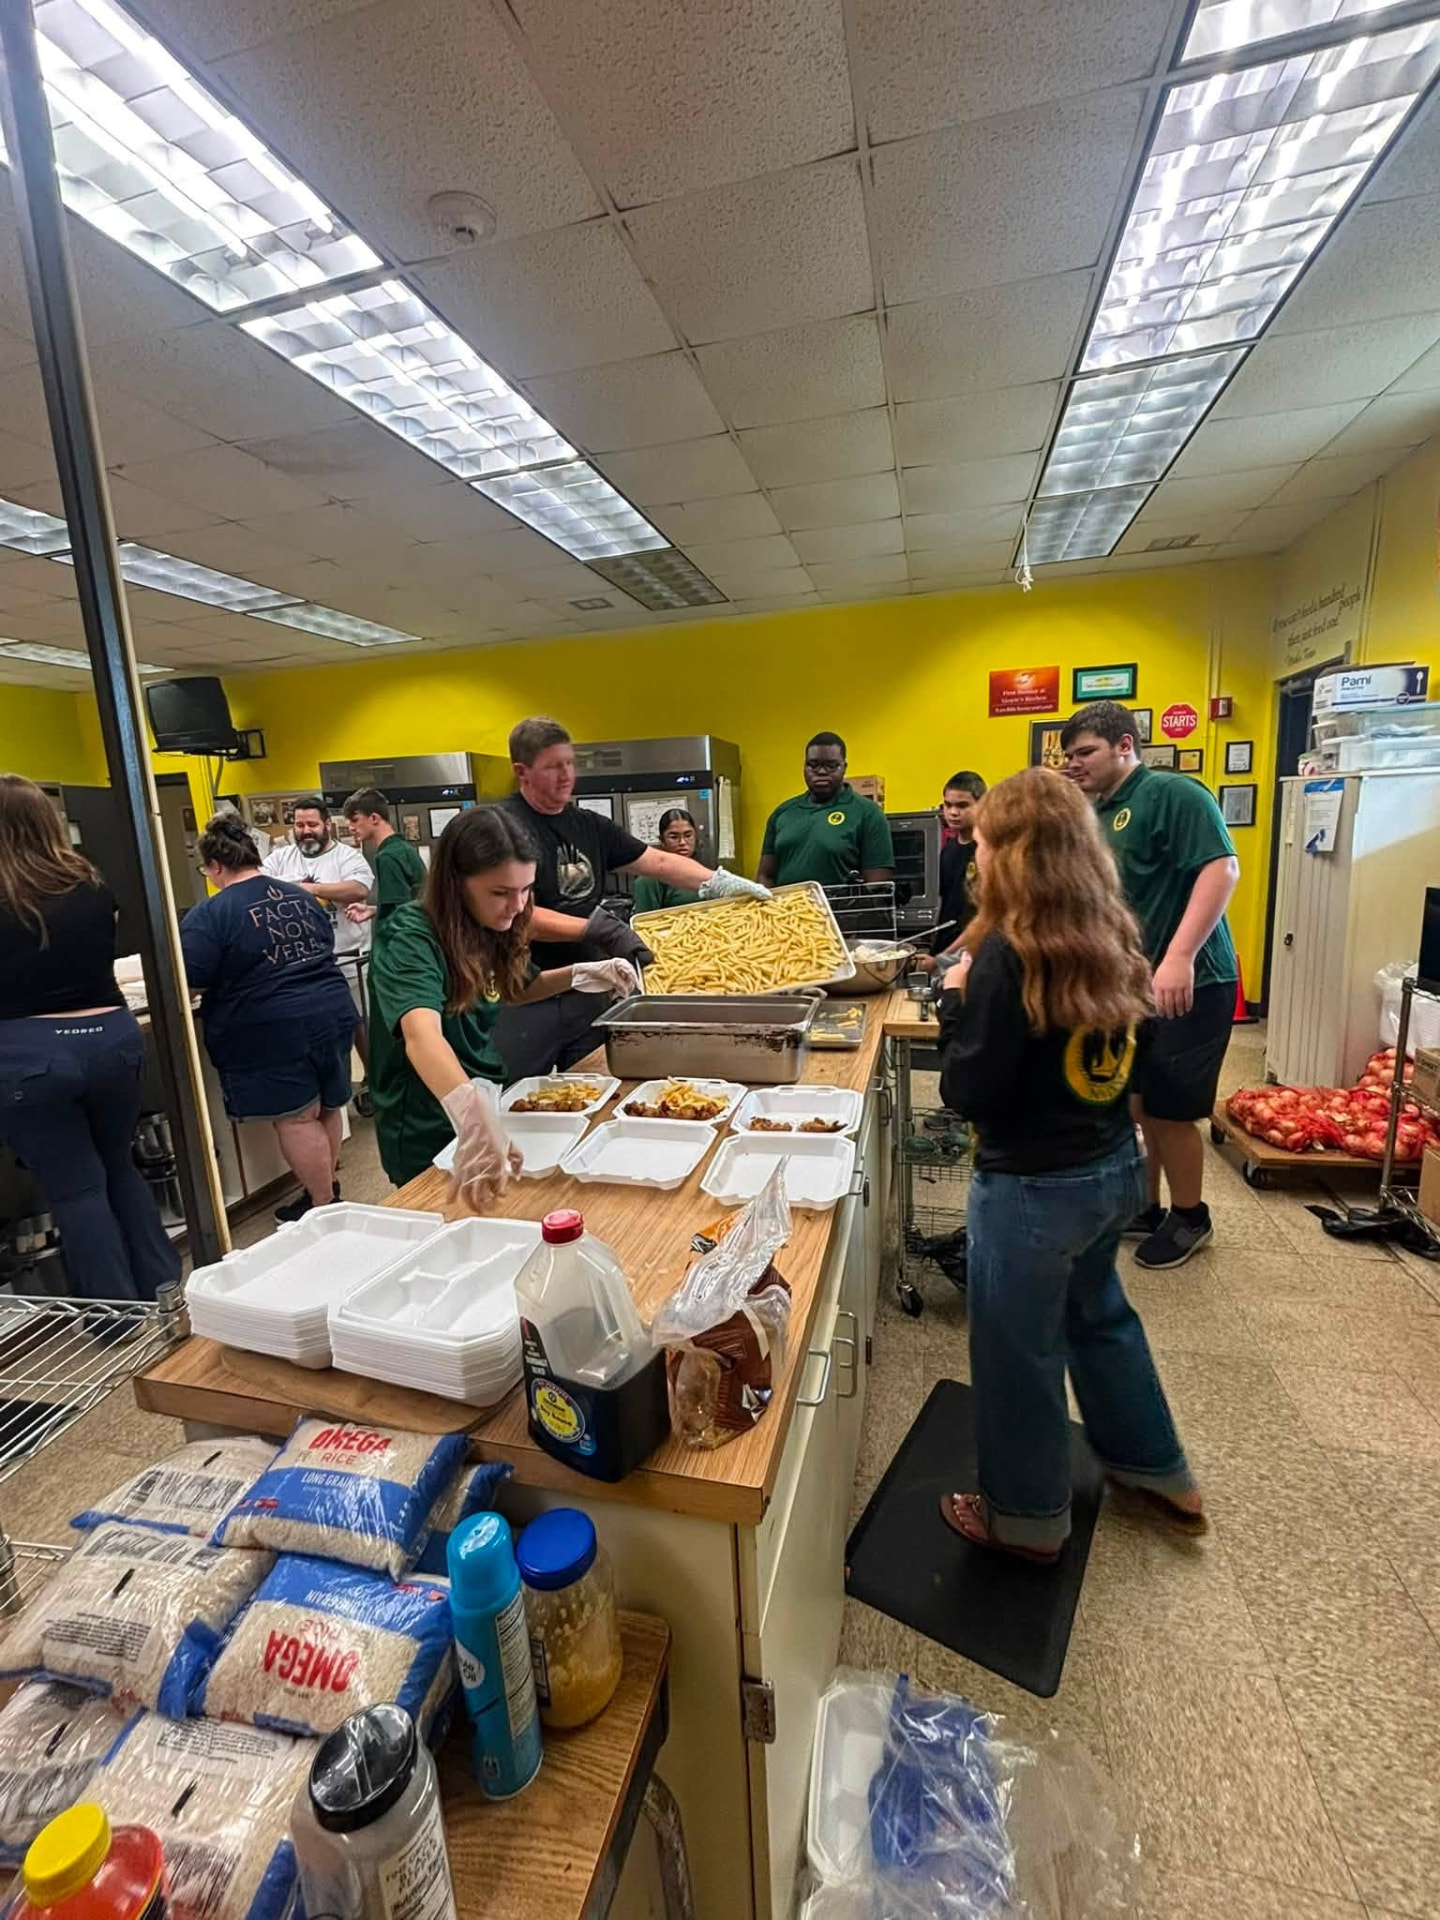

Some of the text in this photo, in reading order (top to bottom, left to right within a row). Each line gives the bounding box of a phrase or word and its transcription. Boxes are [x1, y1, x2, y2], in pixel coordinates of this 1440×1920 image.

[1163, 715, 1196, 728] STARTS
[249, 900, 318, 928] FACTA
[267, 917, 316, 944] NON
[308, 1427, 392, 1455] OMEGA
[321, 1452, 357, 1465] RICE
[301, 1471, 355, 1490] LONG GRAIN
[264, 1629, 360, 1692] OMEGA
